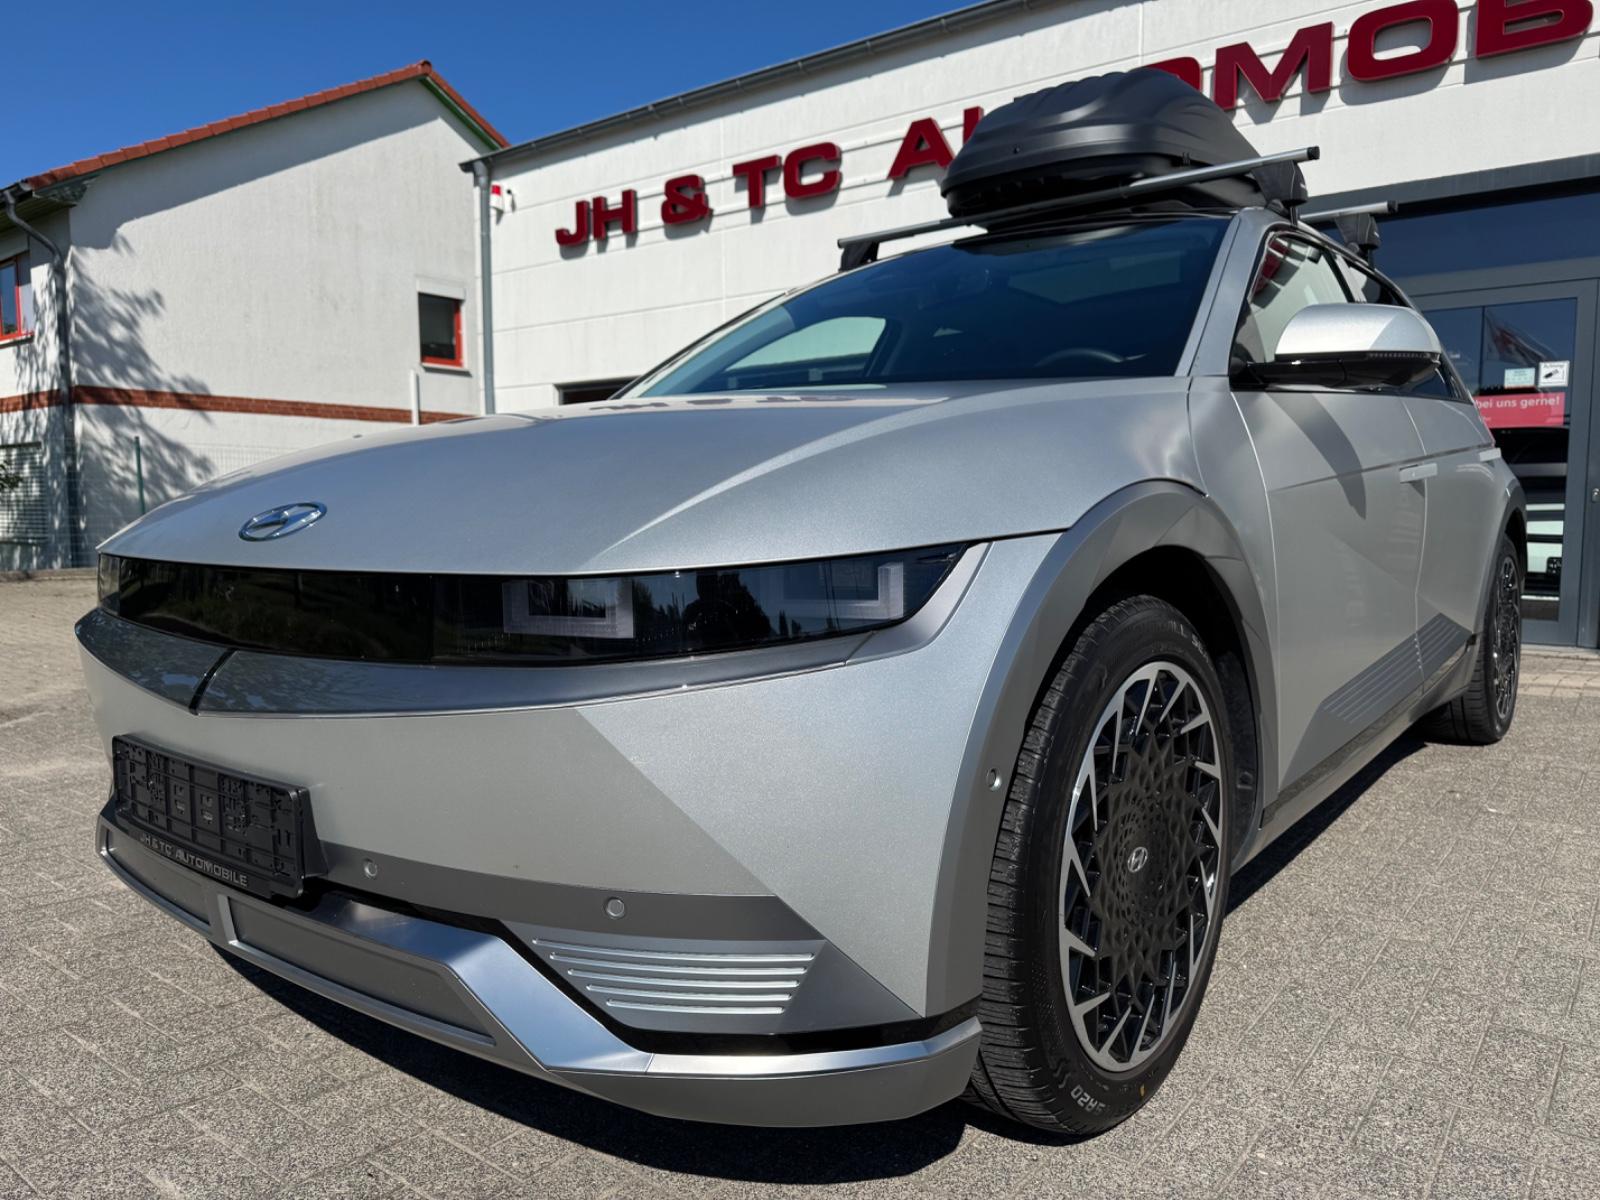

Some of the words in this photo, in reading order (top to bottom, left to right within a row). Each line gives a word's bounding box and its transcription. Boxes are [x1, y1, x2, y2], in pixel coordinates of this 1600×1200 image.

[555, 188, 638, 246] JH
[660, 174, 712, 226] &
[732, 141, 842, 210] TC
[1496, 400, 1518, 409] uns
[1520, 395, 1560, 409] gerne!
[175, 848, 249, 887] AUTOMOBILE
